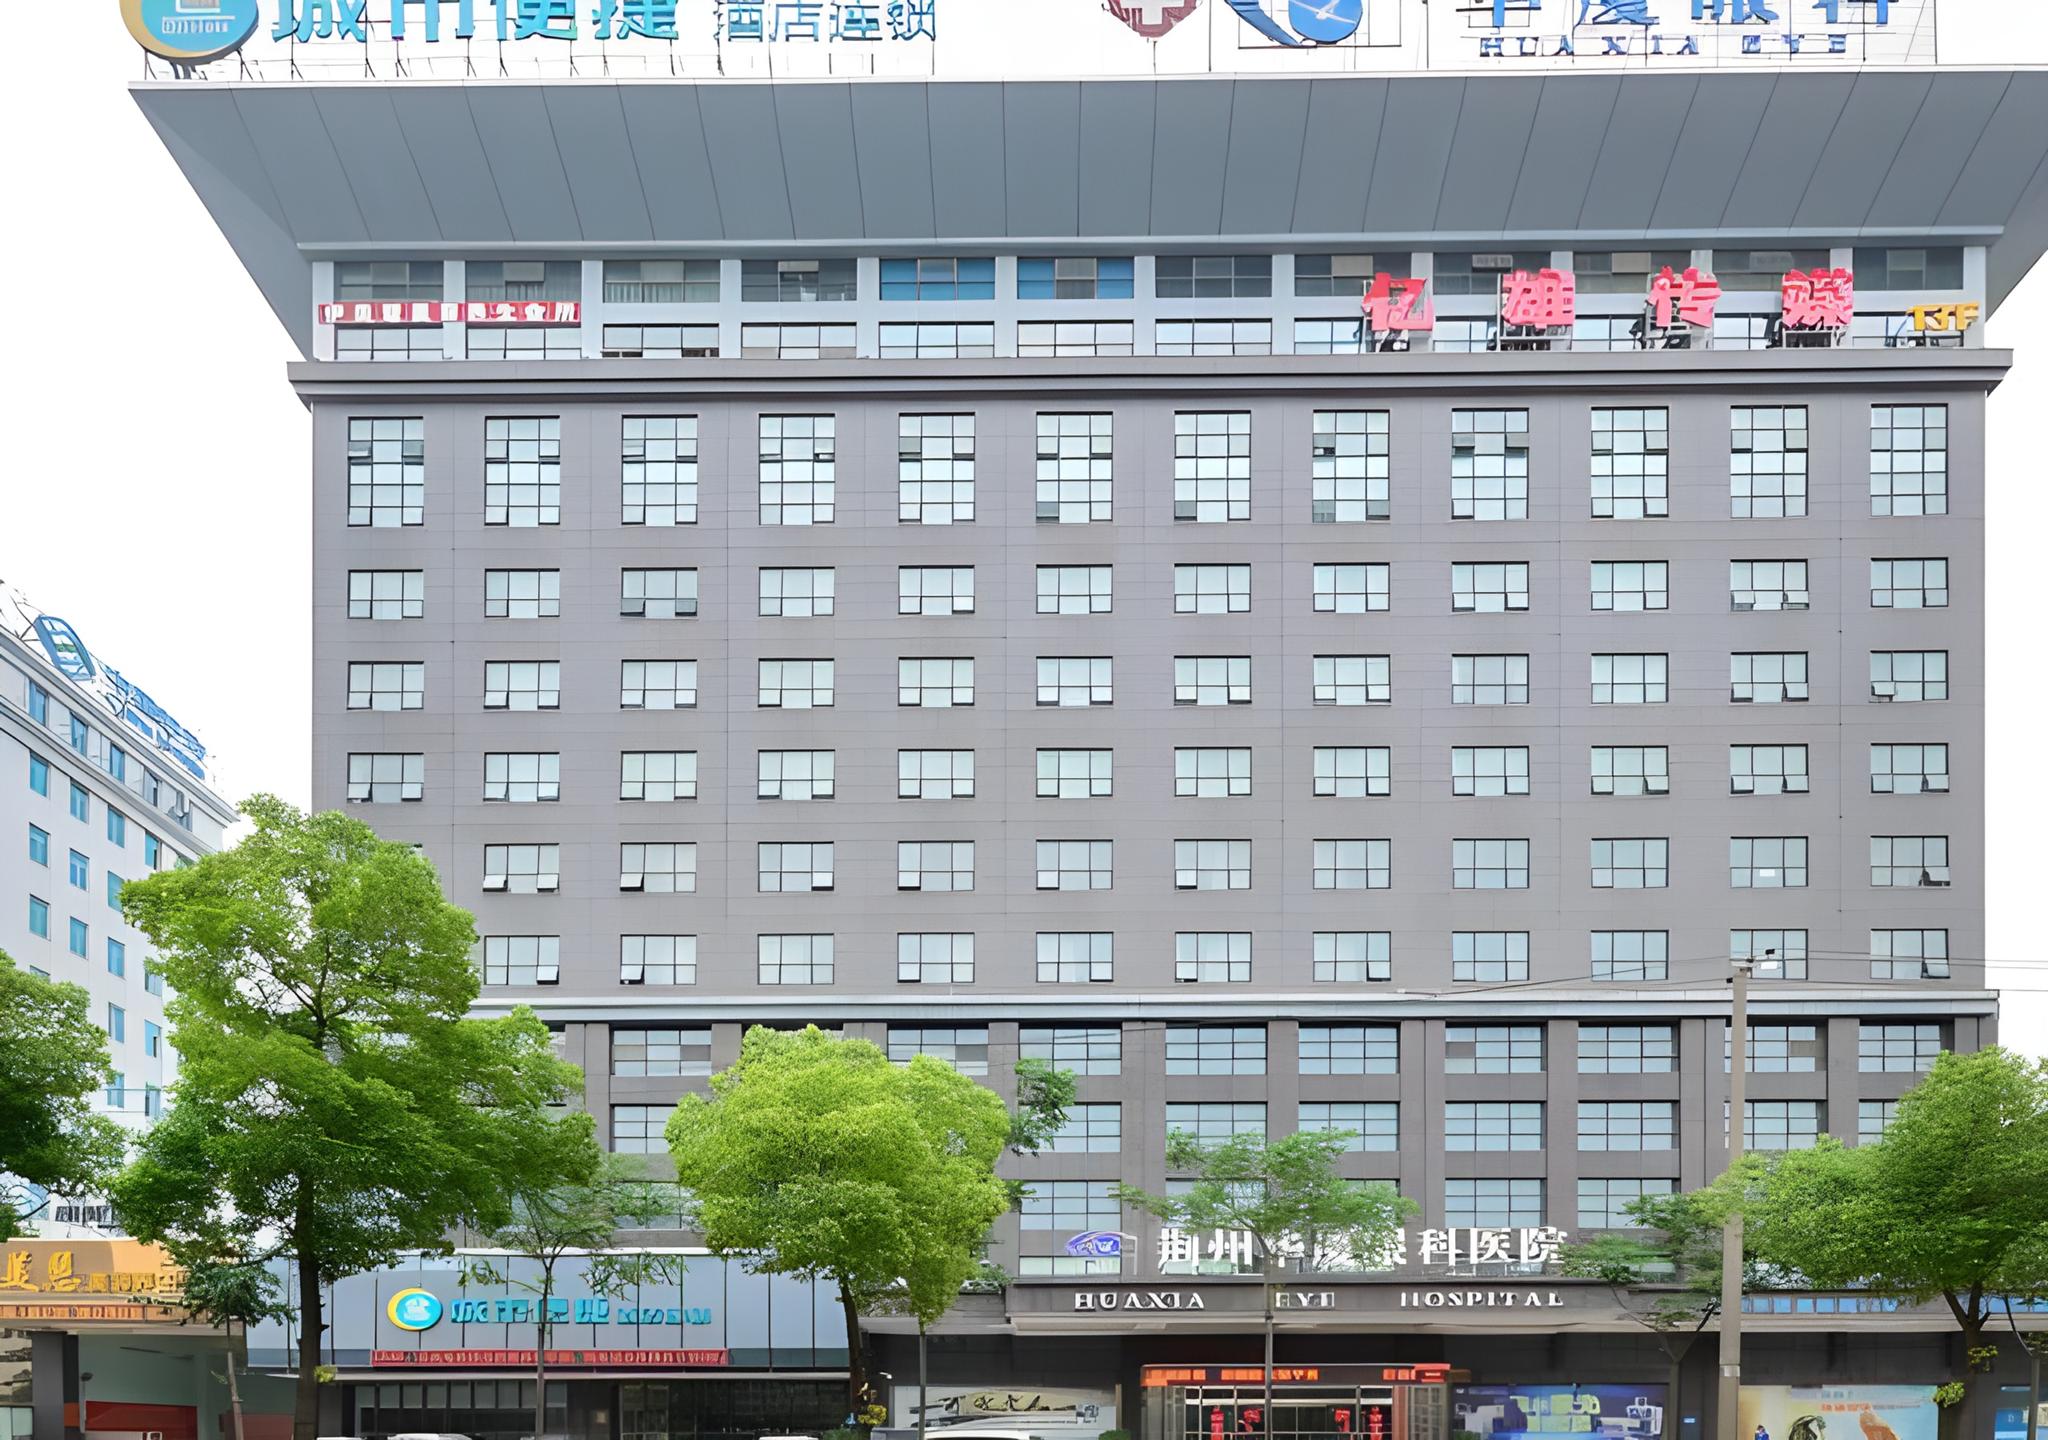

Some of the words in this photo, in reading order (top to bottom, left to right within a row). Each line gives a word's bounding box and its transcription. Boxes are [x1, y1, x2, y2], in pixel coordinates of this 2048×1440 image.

[1157, 1226, 1568, 1272] 荆州华眼科医院
[1400, 1291, 1565, 1308] HOSPITAL
